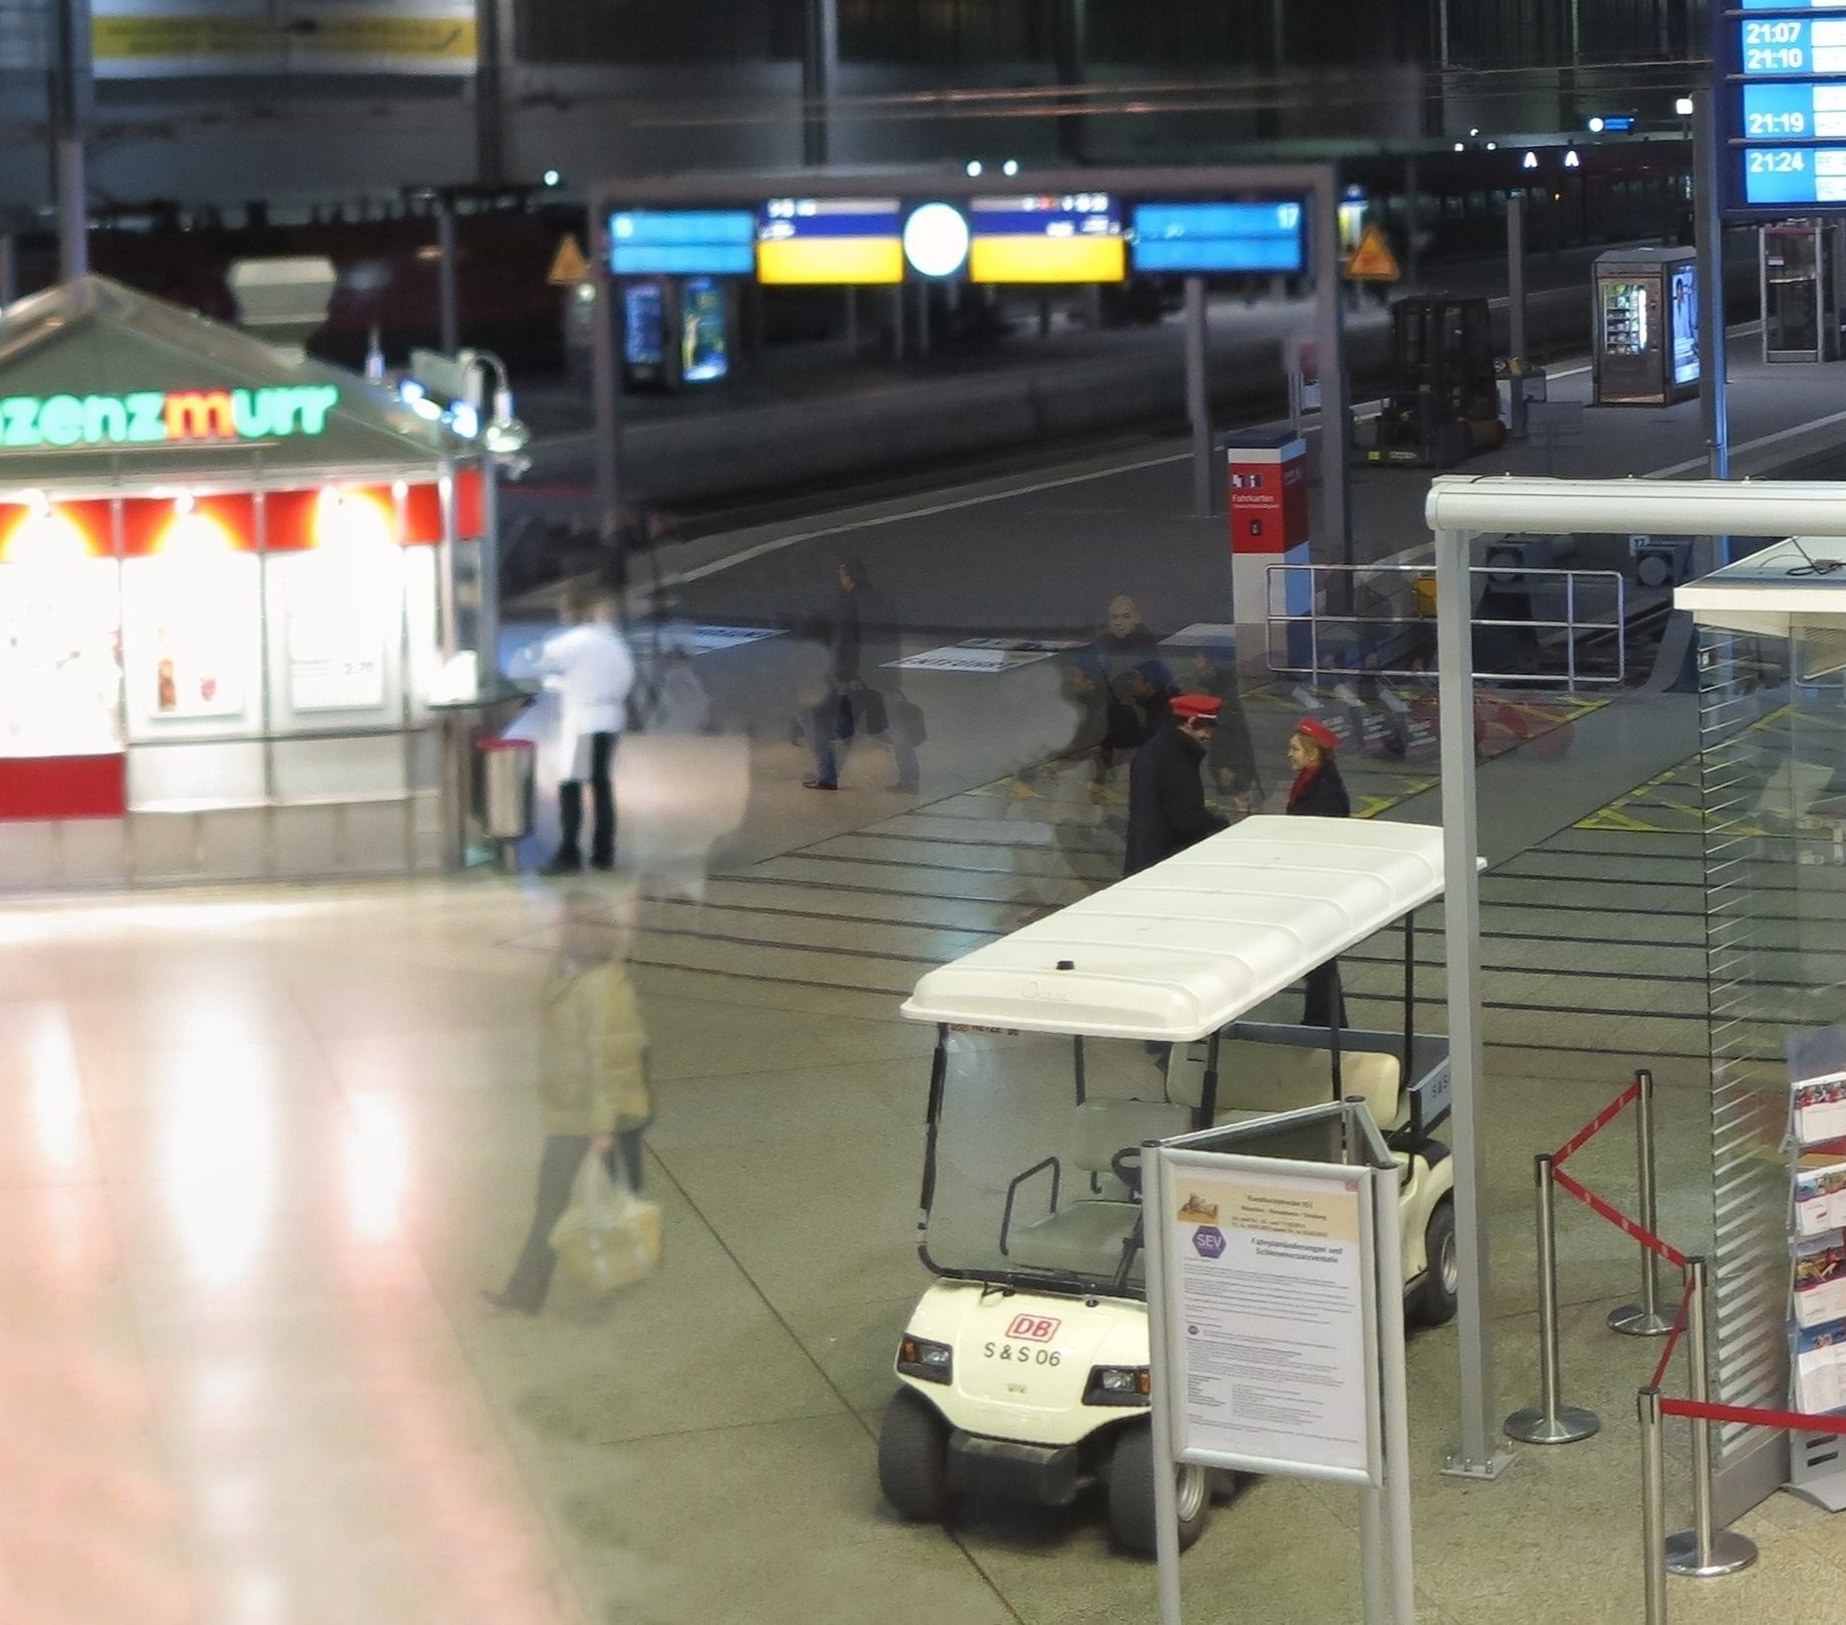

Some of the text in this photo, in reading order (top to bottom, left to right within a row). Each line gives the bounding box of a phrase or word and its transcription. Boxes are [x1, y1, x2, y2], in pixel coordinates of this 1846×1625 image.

[1747, 22, 1801, 44] 21:07
[1748, 48, 1803, 69] 21:10
[1750, 113, 1804, 134] 21:19
[1750, 151, 1804, 173] 21:24
[1196, 1233, 1222, 1249] SEV
[1011, 1316, 1055, 1339] DB
[984, 1342, 1062, 1367] S & S 06
